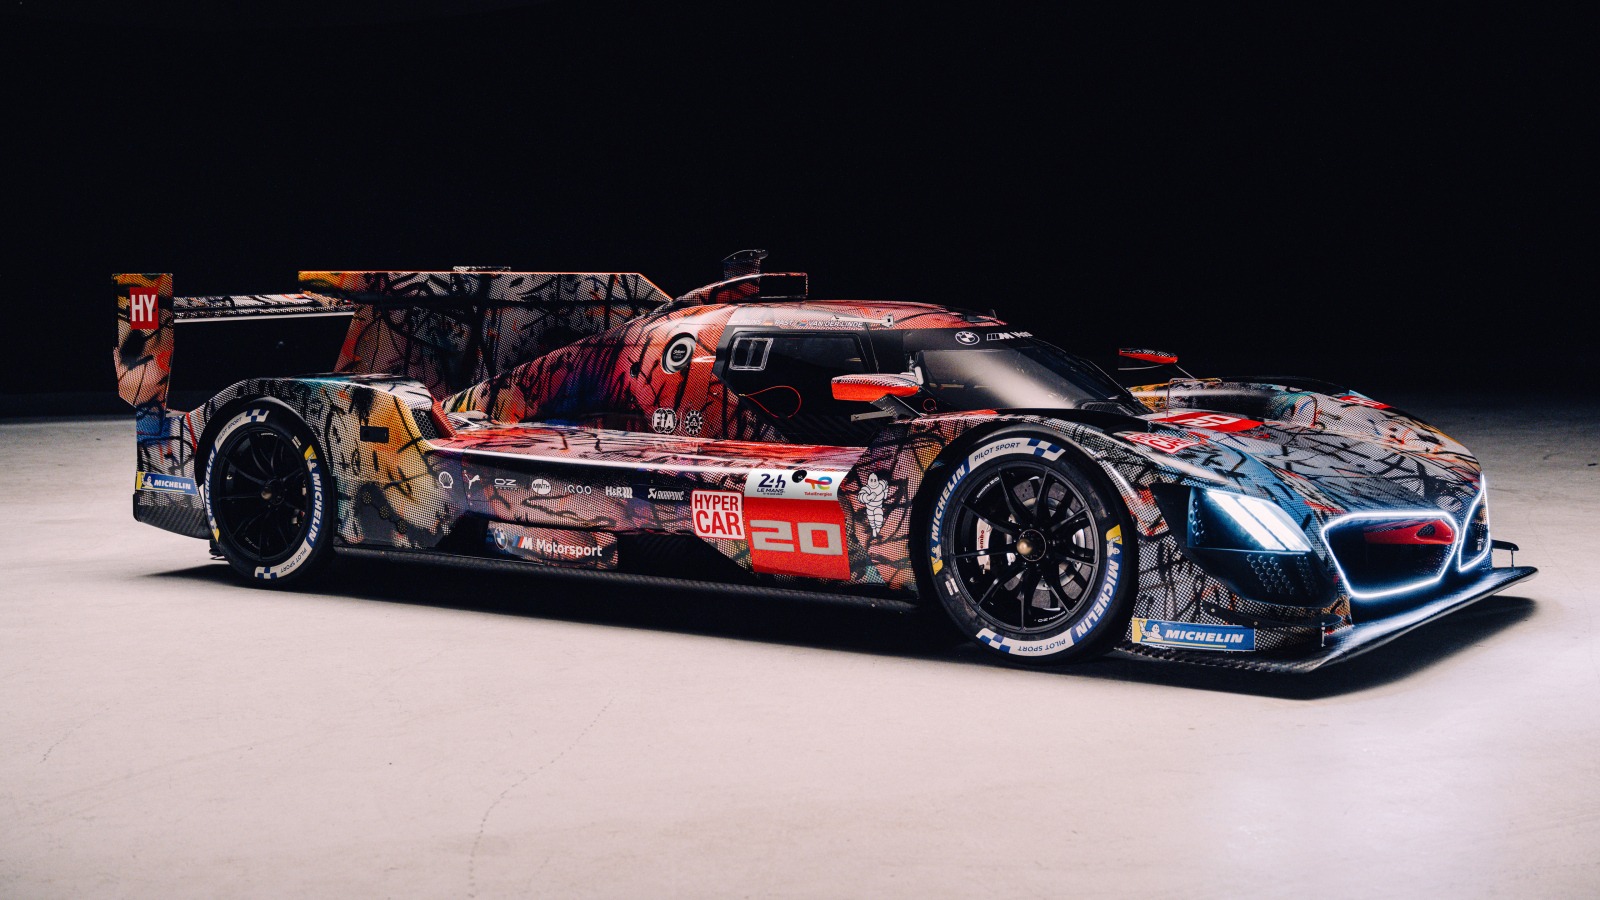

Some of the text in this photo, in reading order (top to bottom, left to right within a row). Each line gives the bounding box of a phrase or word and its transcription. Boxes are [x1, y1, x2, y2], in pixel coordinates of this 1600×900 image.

[131, 294, 156, 322] HY
[217, 417, 243, 443] PILOT SPORT
[653, 412, 674, 429] FIA
[974, 441, 1021, 462] PILOT SPORT
[153, 479, 191, 490] MICHELIN
[204, 449, 216, 517] MICHELIN
[494, 478, 517, 486] OZ
[308, 472, 323, 543] MICHELIN
[694, 493, 739, 512] HYPER
[931, 464, 966, 542] MICHELIN
[695, 510, 742, 536] CAR
[536, 538, 603, 558] Motorsport
[749, 519, 843, 556] 20
[281, 561, 296, 573] SPORT
[1077, 562, 1120, 637] MICHELIN
[1018, 638, 1067, 653] PILOT SPORT
[1165, 629, 1245, 643] MICHELIN
